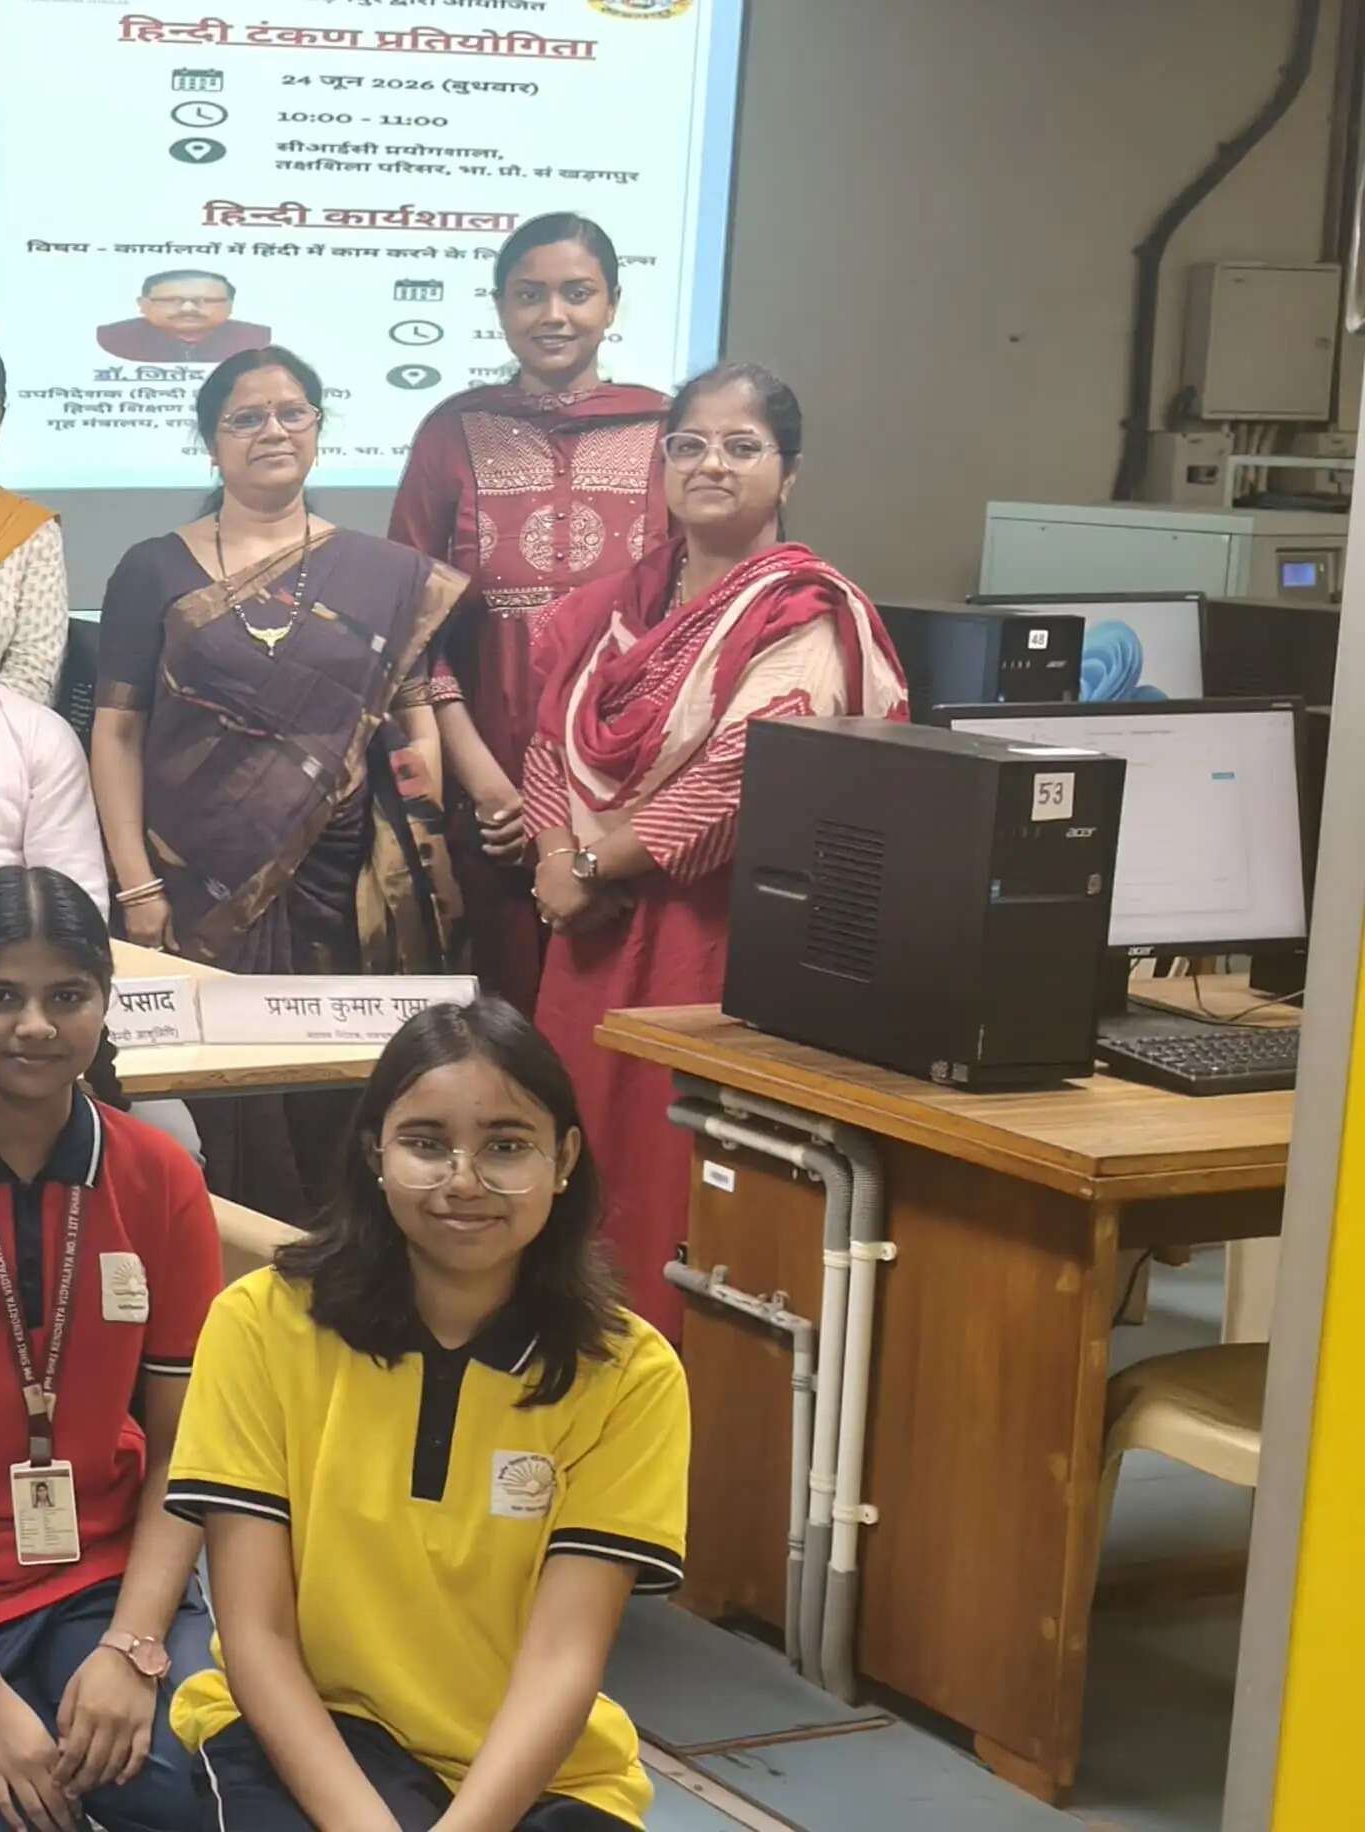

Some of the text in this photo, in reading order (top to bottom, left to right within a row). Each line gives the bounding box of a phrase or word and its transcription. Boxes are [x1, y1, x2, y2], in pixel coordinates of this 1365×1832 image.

[118, 14, 599, 58] हिन्दी टंकण प्रतियोगिता
[281, 75, 311, 86] 24
[319, 75, 365, 91] जून
[371, 78, 435, 91] 2026
[277, 111, 353, 124] 10:00
[379, 115, 449, 127] 11:00
[202, 200, 519, 231] हिन्दी कार्यशाला
[1038, 782, 1063, 805] 53
[118, 990, 176, 1012] प्रसाद
[264, 997, 322, 1016] प्रभात
[328, 997, 384, 1022] कुमार
